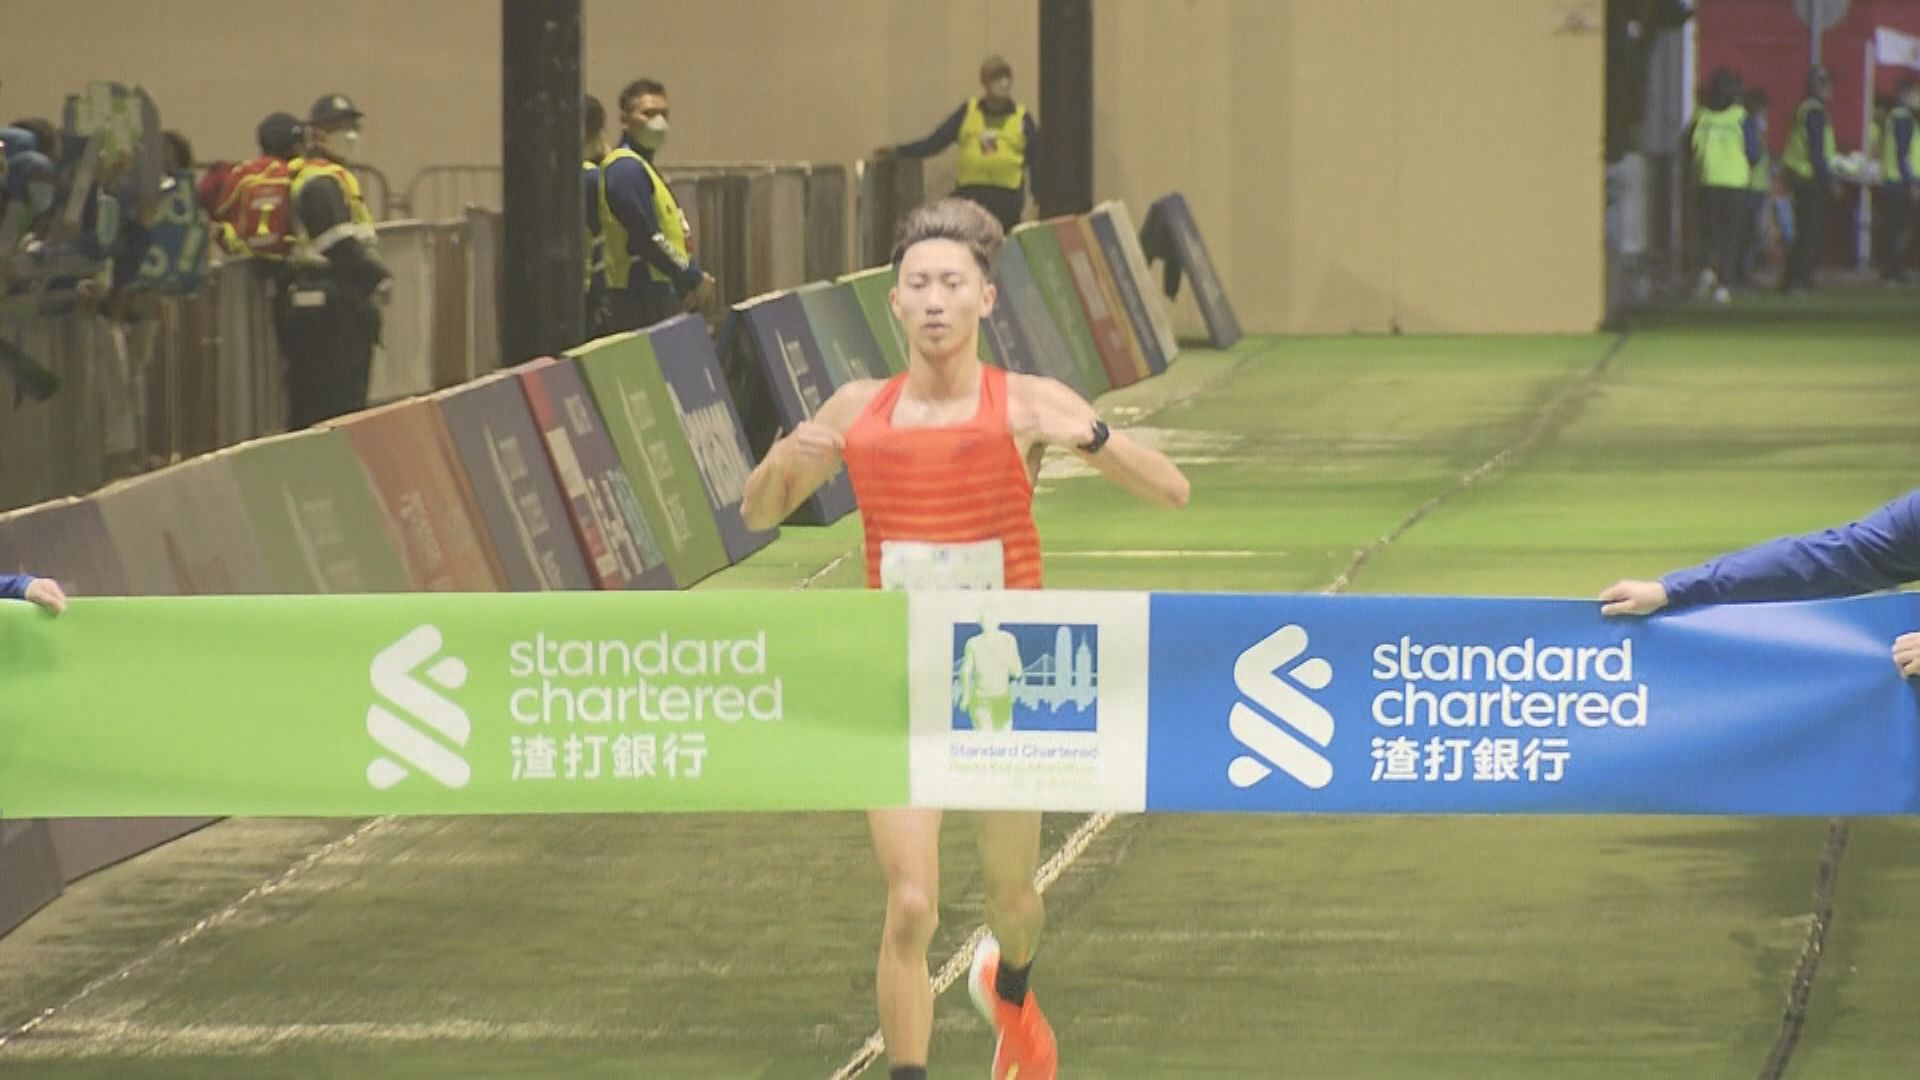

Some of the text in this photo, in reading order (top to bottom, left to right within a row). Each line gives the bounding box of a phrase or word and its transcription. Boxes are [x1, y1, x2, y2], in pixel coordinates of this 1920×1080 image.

[510, 631, 767, 676] standard
[1373, 637, 1632, 681] standard
[510, 676, 783, 723] chartered
[1373, 682, 1648, 727] chartered
[511, 734, 707, 779] 渣打銀行
[950, 743, 1098, 758] Standard Chartered
[1371, 736, 1570, 781] 渣打銀行
